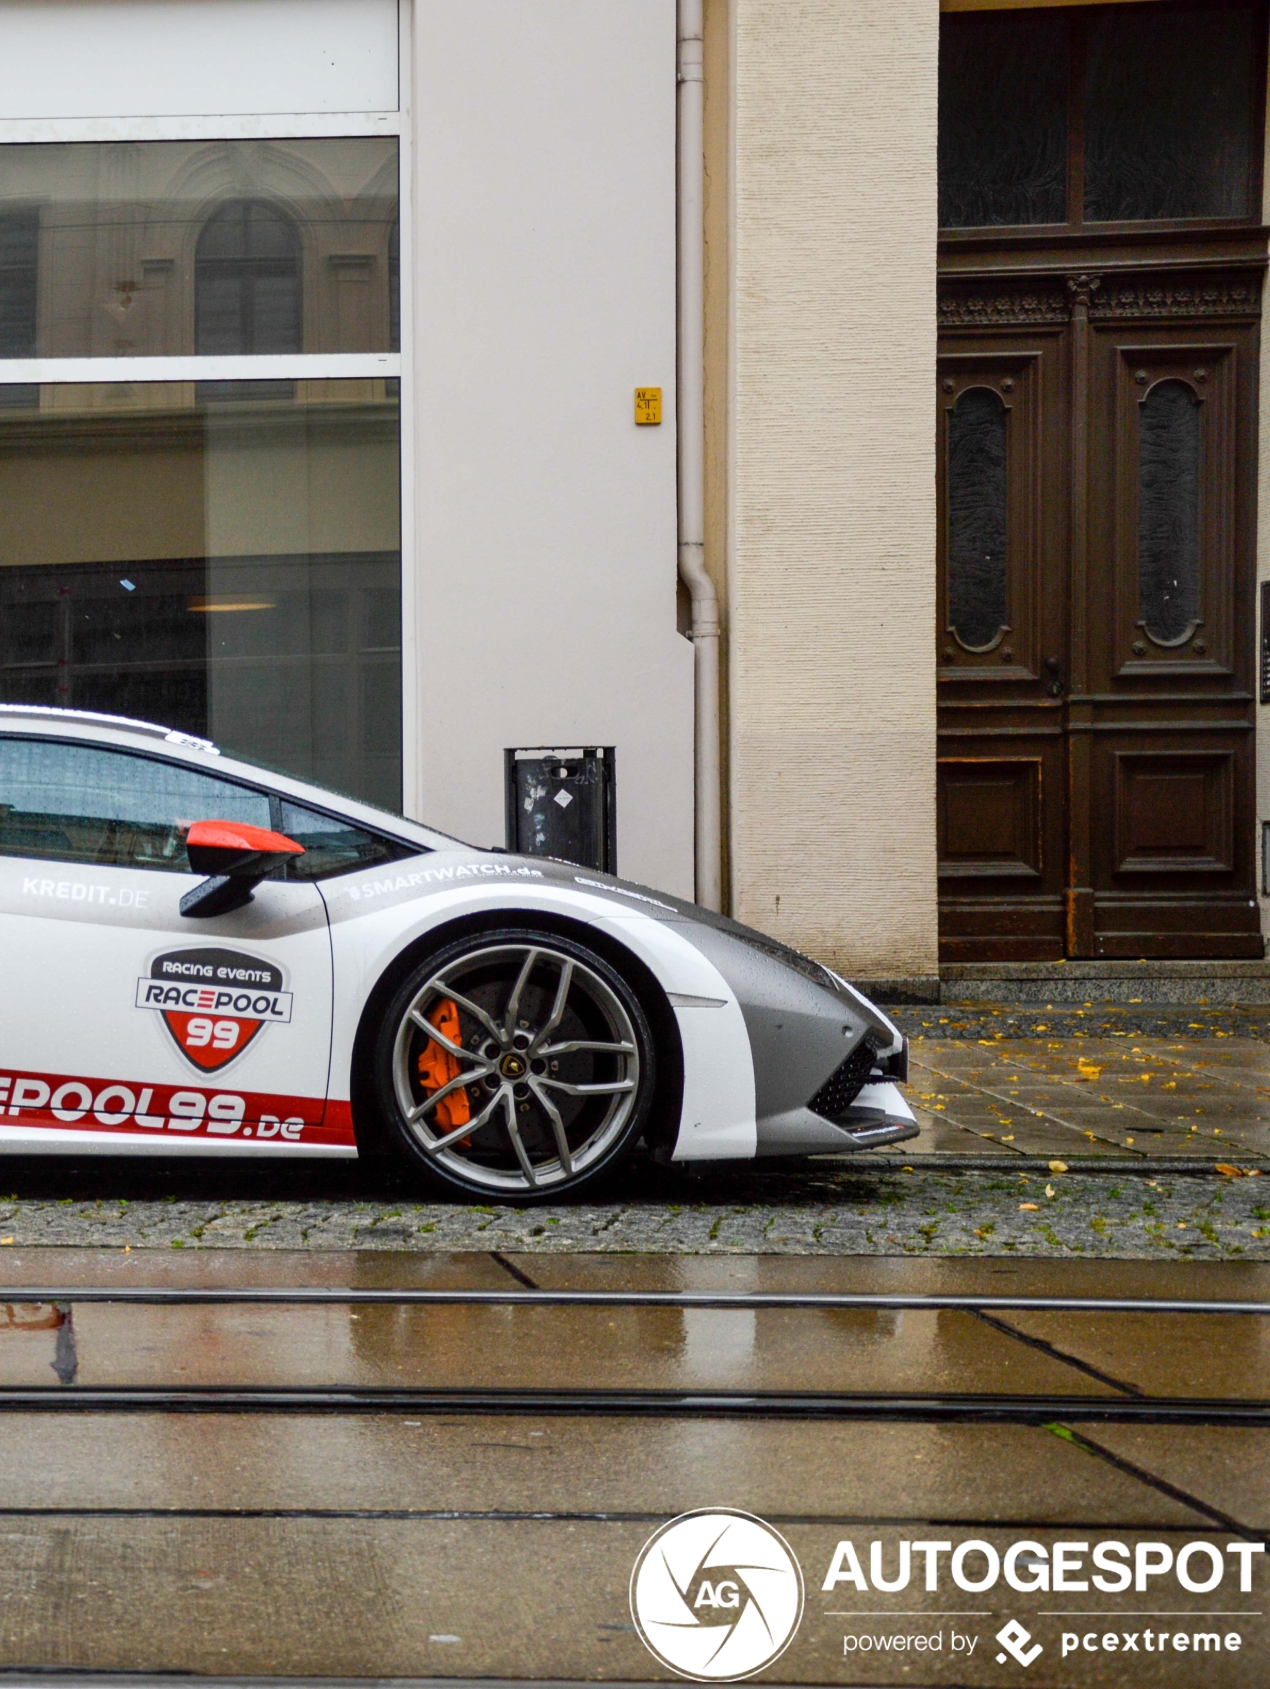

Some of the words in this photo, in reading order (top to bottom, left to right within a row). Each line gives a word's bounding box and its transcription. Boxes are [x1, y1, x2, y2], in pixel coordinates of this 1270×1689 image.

[21, 877, 149, 909] KREDIT.DE
[361, 863, 543, 898] SMARTWATCH.de
[145, 984, 285, 1016] RACEPOOL
[186, 1018, 240, 1049] 99
